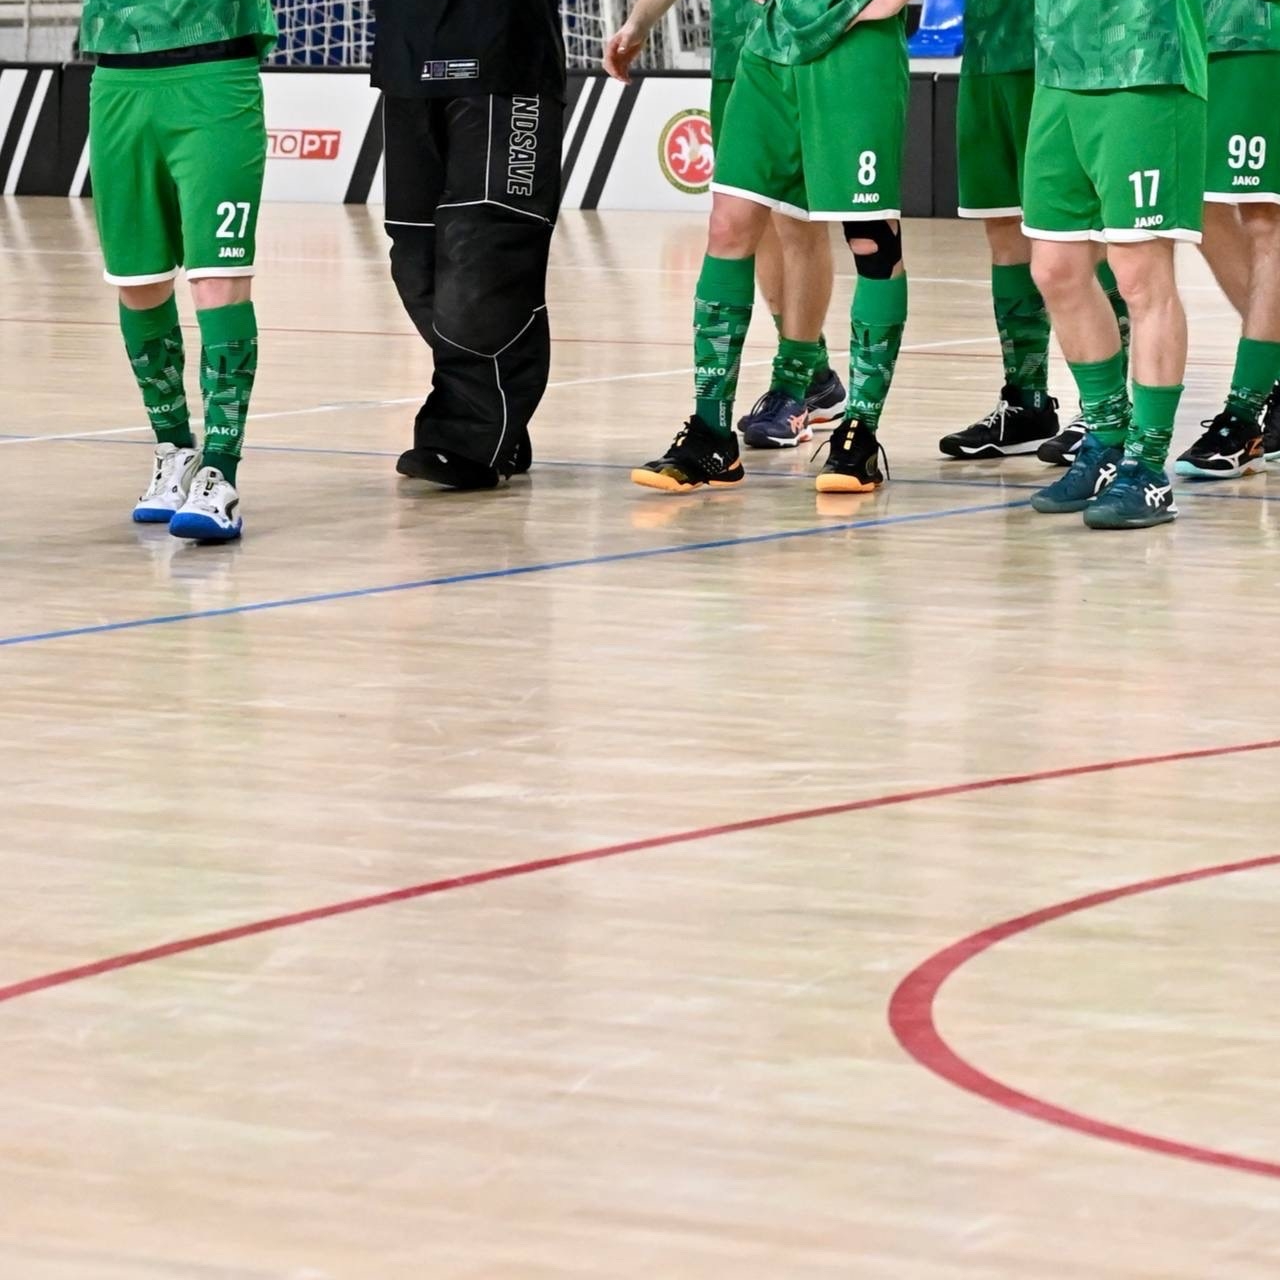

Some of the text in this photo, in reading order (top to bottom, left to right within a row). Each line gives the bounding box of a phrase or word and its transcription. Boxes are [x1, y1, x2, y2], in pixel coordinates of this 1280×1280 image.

[1228, 135, 1266, 170] 99
[858, 150, 877, 186] 8
[1232, 175, 1260, 186] JAKO
[1128, 169, 1160, 208] 17
[852, 193, 880, 204] JAKO
[216, 201, 251, 238] 27
[1134, 214, 1163, 228] JAKO
[218, 247, 245, 258] JAKO
[205, 425, 239, 437] JAKO
